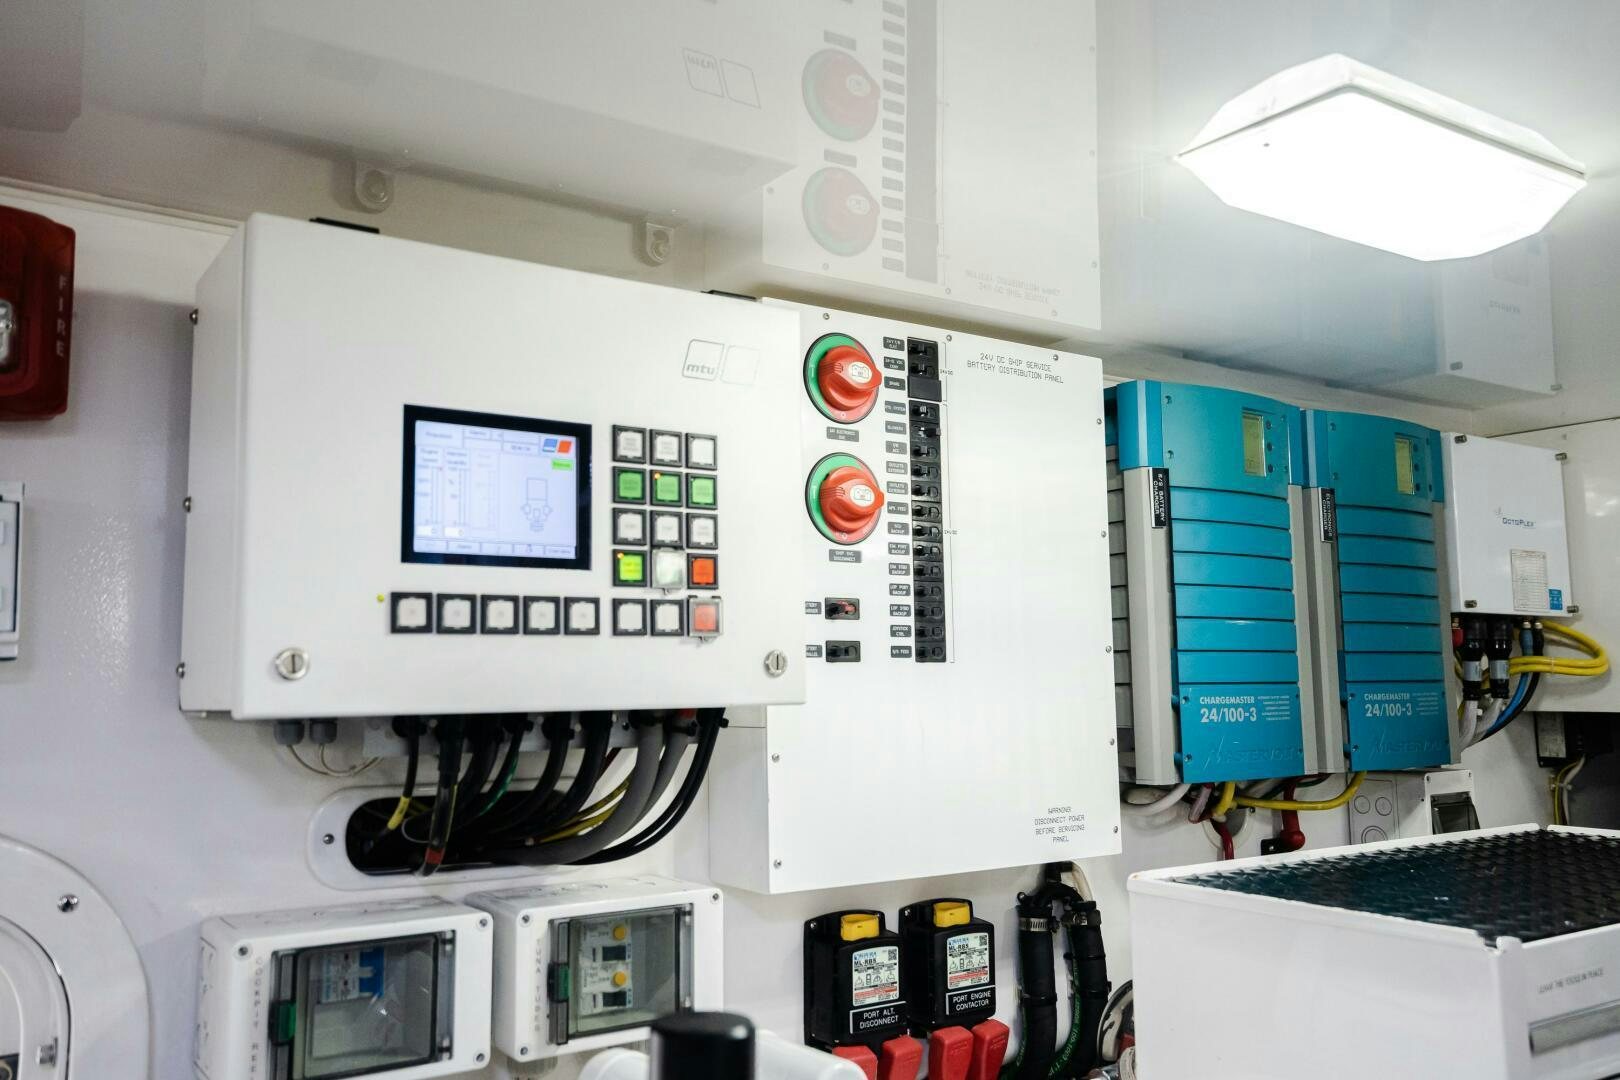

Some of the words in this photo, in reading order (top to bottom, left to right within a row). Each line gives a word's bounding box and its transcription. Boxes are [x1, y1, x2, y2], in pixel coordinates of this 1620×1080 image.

[980, 352, 994, 361] 24V
[997, 355, 1005, 364] DC
[1008, 358, 1023, 367] SHIP
[1026, 361, 1052, 372] SERVICE
[687, 364, 716, 375] mtu
[967, 360, 996, 372] BATTERY
[998, 366, 1042, 380] DISTRIBUTION
[1044, 373, 1064, 384] PANEL
[1200, 695, 1255, 705] CHARGEMASTER
[1364, 692, 1410, 701] CHARGEMASTER
[1200, 706, 1257, 723] 24/100-3
[1365, 703, 1412, 717] 24/100-3
[1047, 806, 1072, 814] WARNING
[1034, 816, 1066, 826] DISCONNECT
[1068, 814, 1085, 822] POWER
[1035, 827, 1056, 835] BEFORE
[1058, 824, 1085, 833] SERVICING
[1052, 835, 1069, 843] PANEL
[952, 994, 968, 1004] PORT
[970, 990, 991, 1000] ENGINE
[955, 998, 989, 1011] CONTACTOR
[863, 1009, 880, 1020] PORT
[882, 1007, 896, 1016] ALT.
[859, 1015, 899, 1030] DISCONNECT
